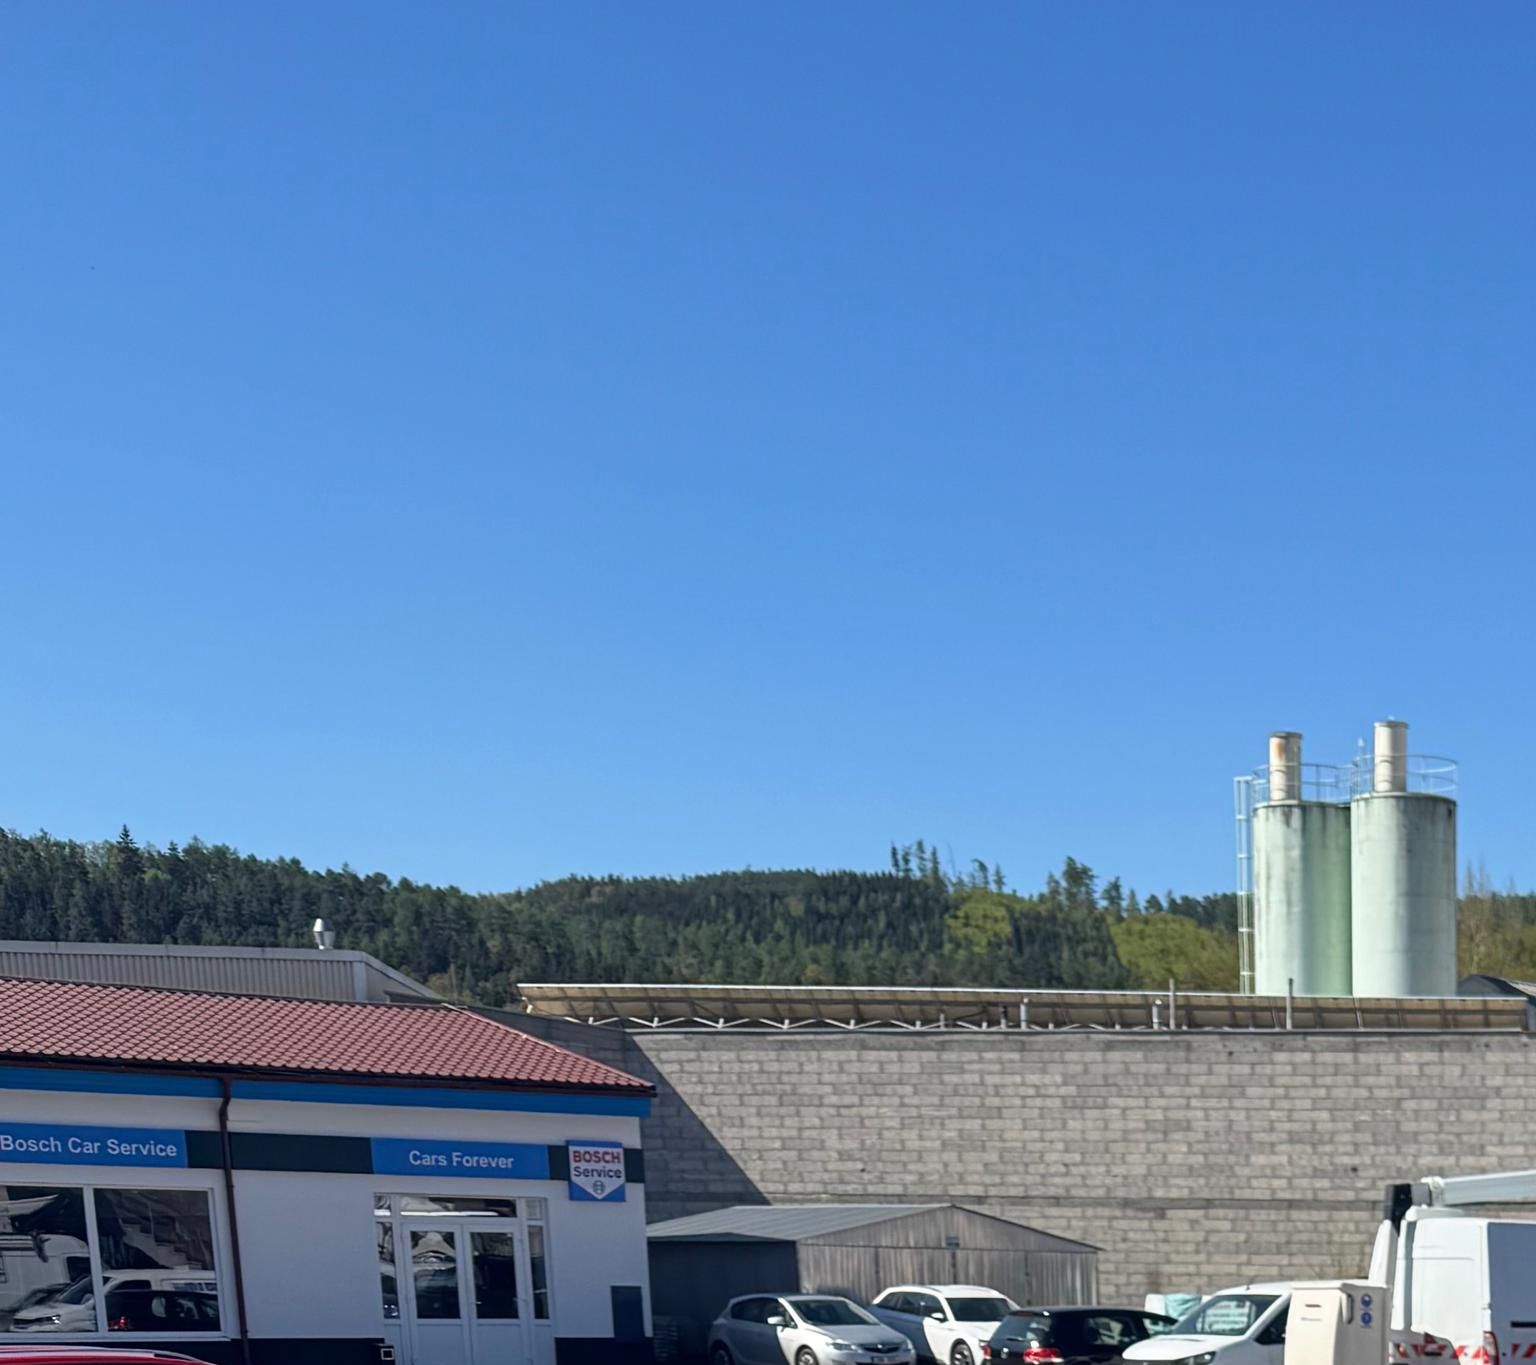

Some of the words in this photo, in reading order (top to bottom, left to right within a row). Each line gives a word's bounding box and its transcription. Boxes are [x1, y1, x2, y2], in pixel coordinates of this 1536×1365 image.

[0, 1135, 62, 1153] Bosch
[68, 1137, 101, 1154] Car
[107, 1138, 178, 1157] Service
[409, 1150, 447, 1167] Cars
[452, 1152, 515, 1168] Forever
[572, 1150, 622, 1165] BOSCH
[573, 1165, 623, 1179] Service
